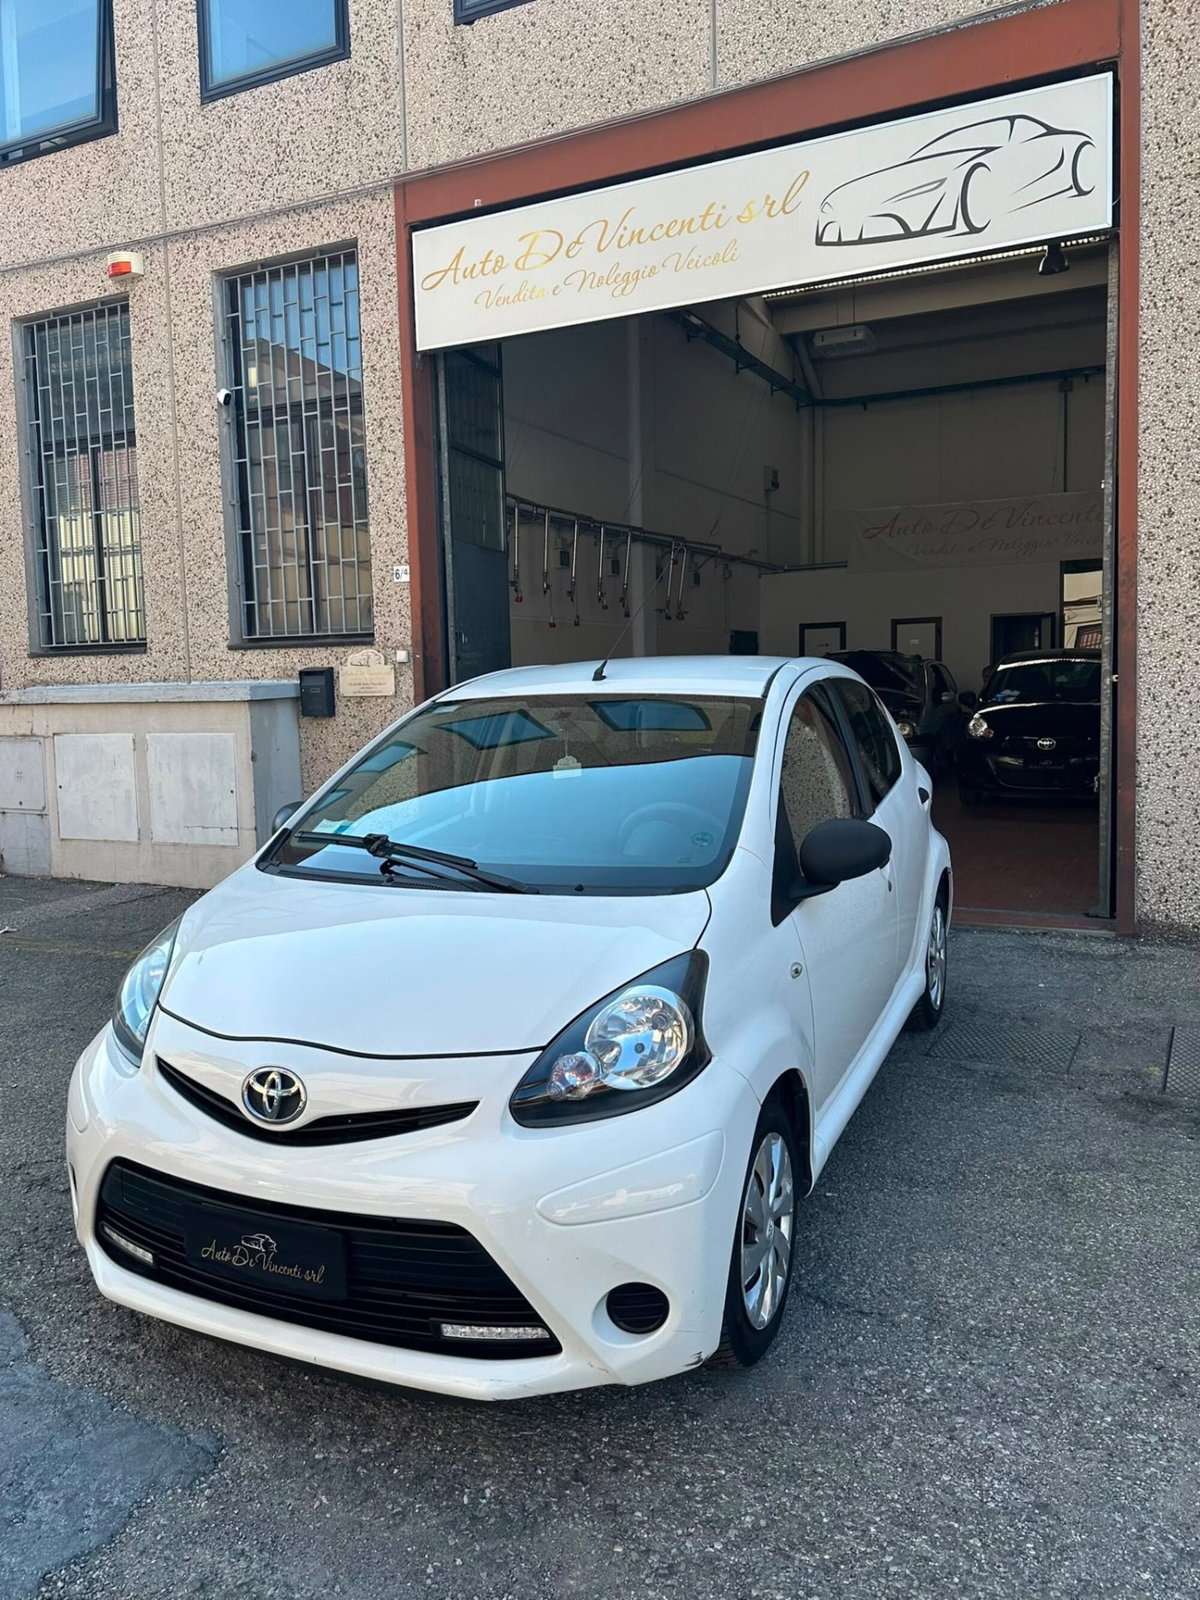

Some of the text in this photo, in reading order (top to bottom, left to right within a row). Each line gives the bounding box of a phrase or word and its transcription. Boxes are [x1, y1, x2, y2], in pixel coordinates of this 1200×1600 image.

[421, 170, 810, 291] Auto De Vincenti srl
[474, 238, 740, 309] Vendita e Noleggio Veicoli
[862, 511, 933, 540] Auto
[201, 1239, 232, 1261] Auto
[255, 1252, 303, 1279] Vincenti
[303, 1264, 326, 1285] srl
